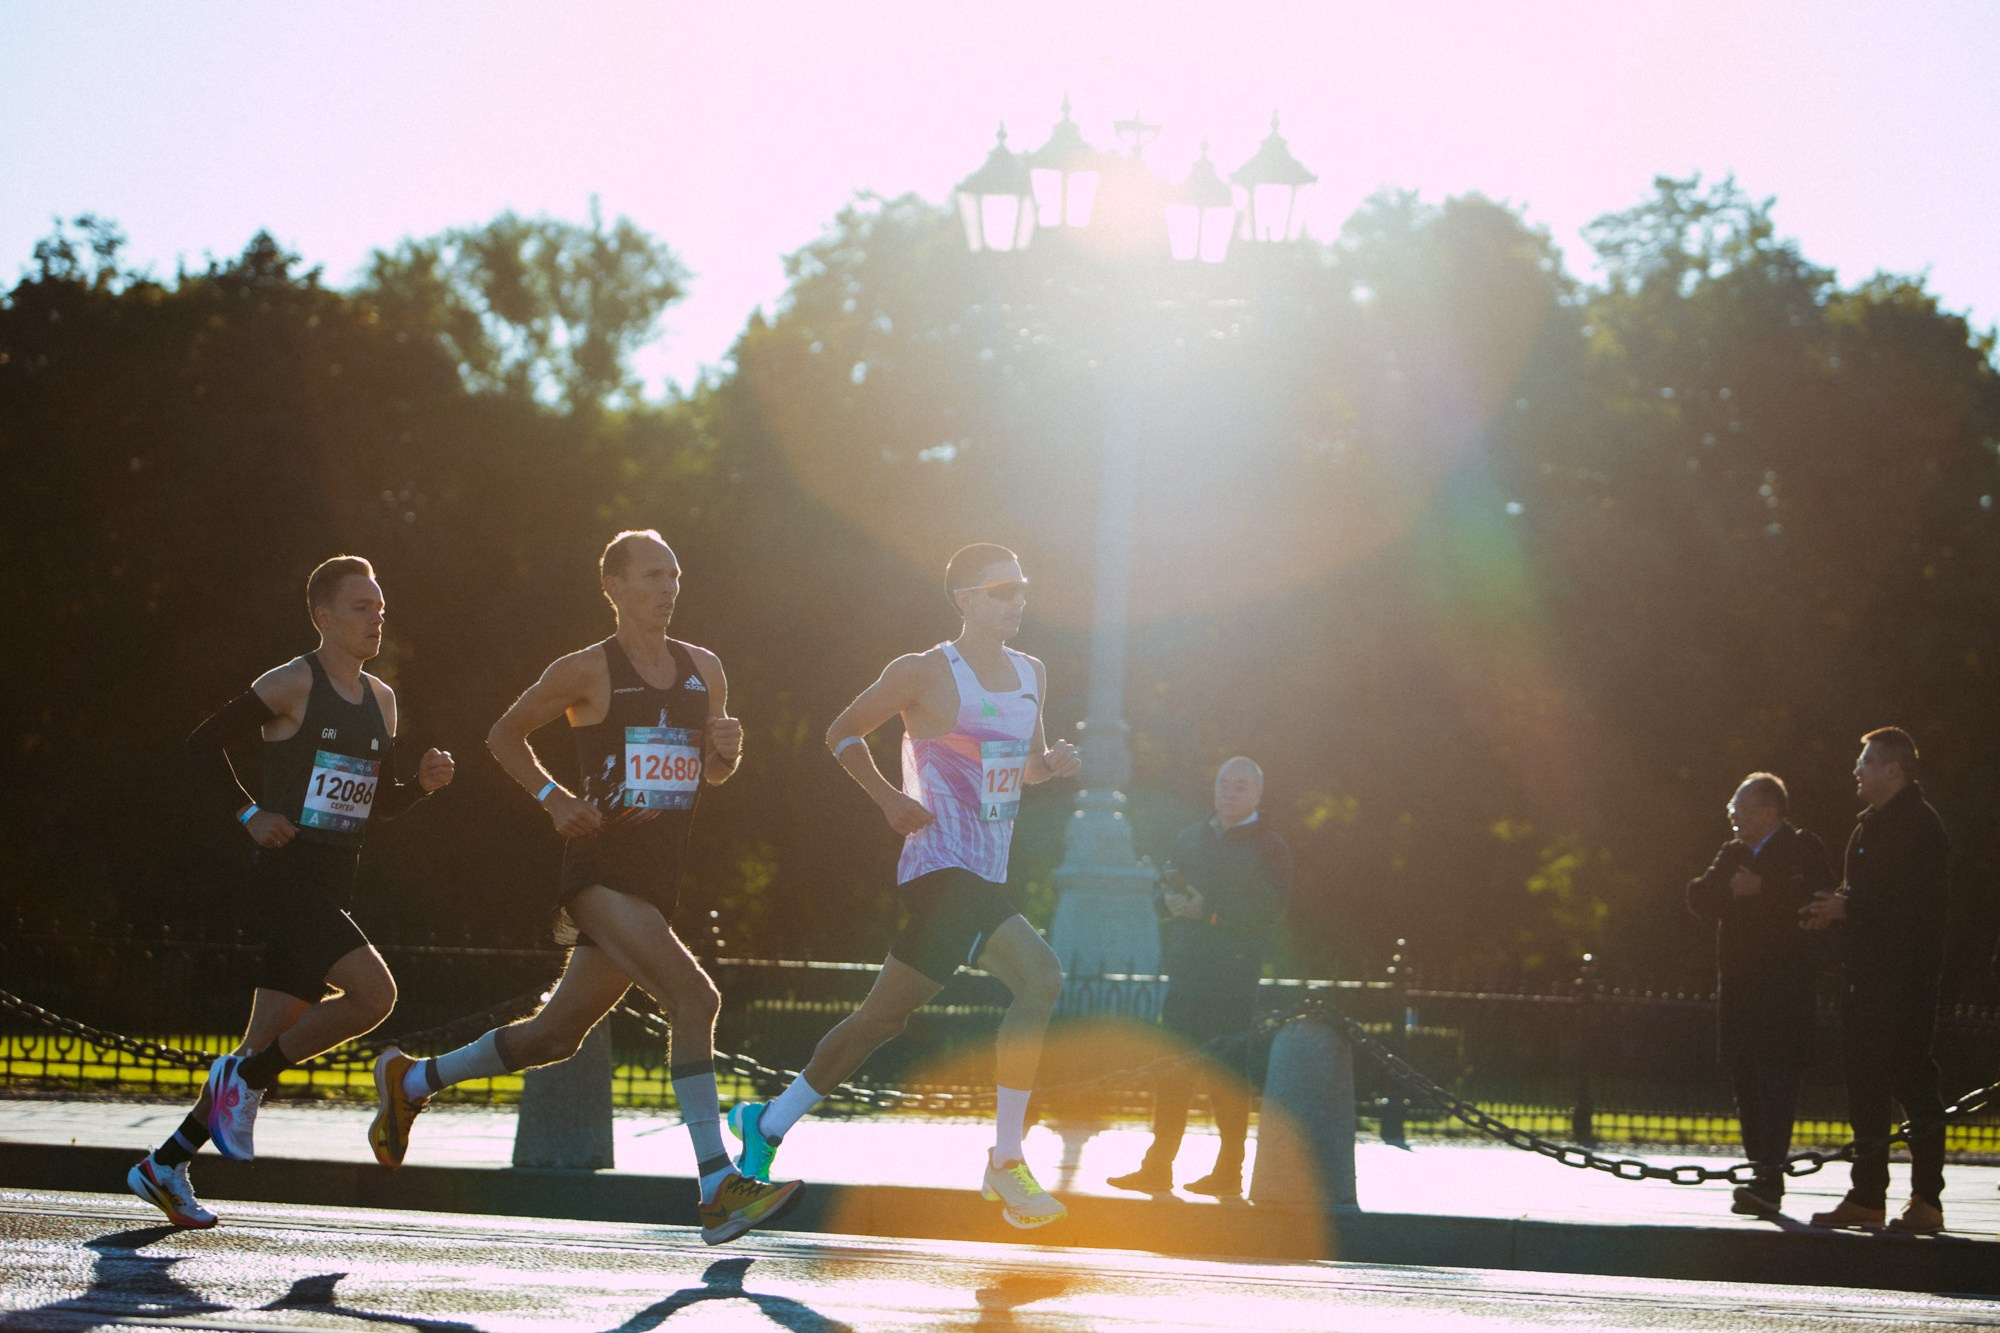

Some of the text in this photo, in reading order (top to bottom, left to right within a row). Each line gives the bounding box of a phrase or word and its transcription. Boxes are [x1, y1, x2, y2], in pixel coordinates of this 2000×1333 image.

[684, 683, 706, 692] adidas
[630, 754, 699, 781] 12680
[987, 767, 1023, 793] 127
[315, 773, 375, 805] 12086
[635, 791, 646, 805] A
[330, 801, 355, 812] СЕРГЕЙ
[989, 804, 998, 818] A
[309, 812, 319, 825] A
